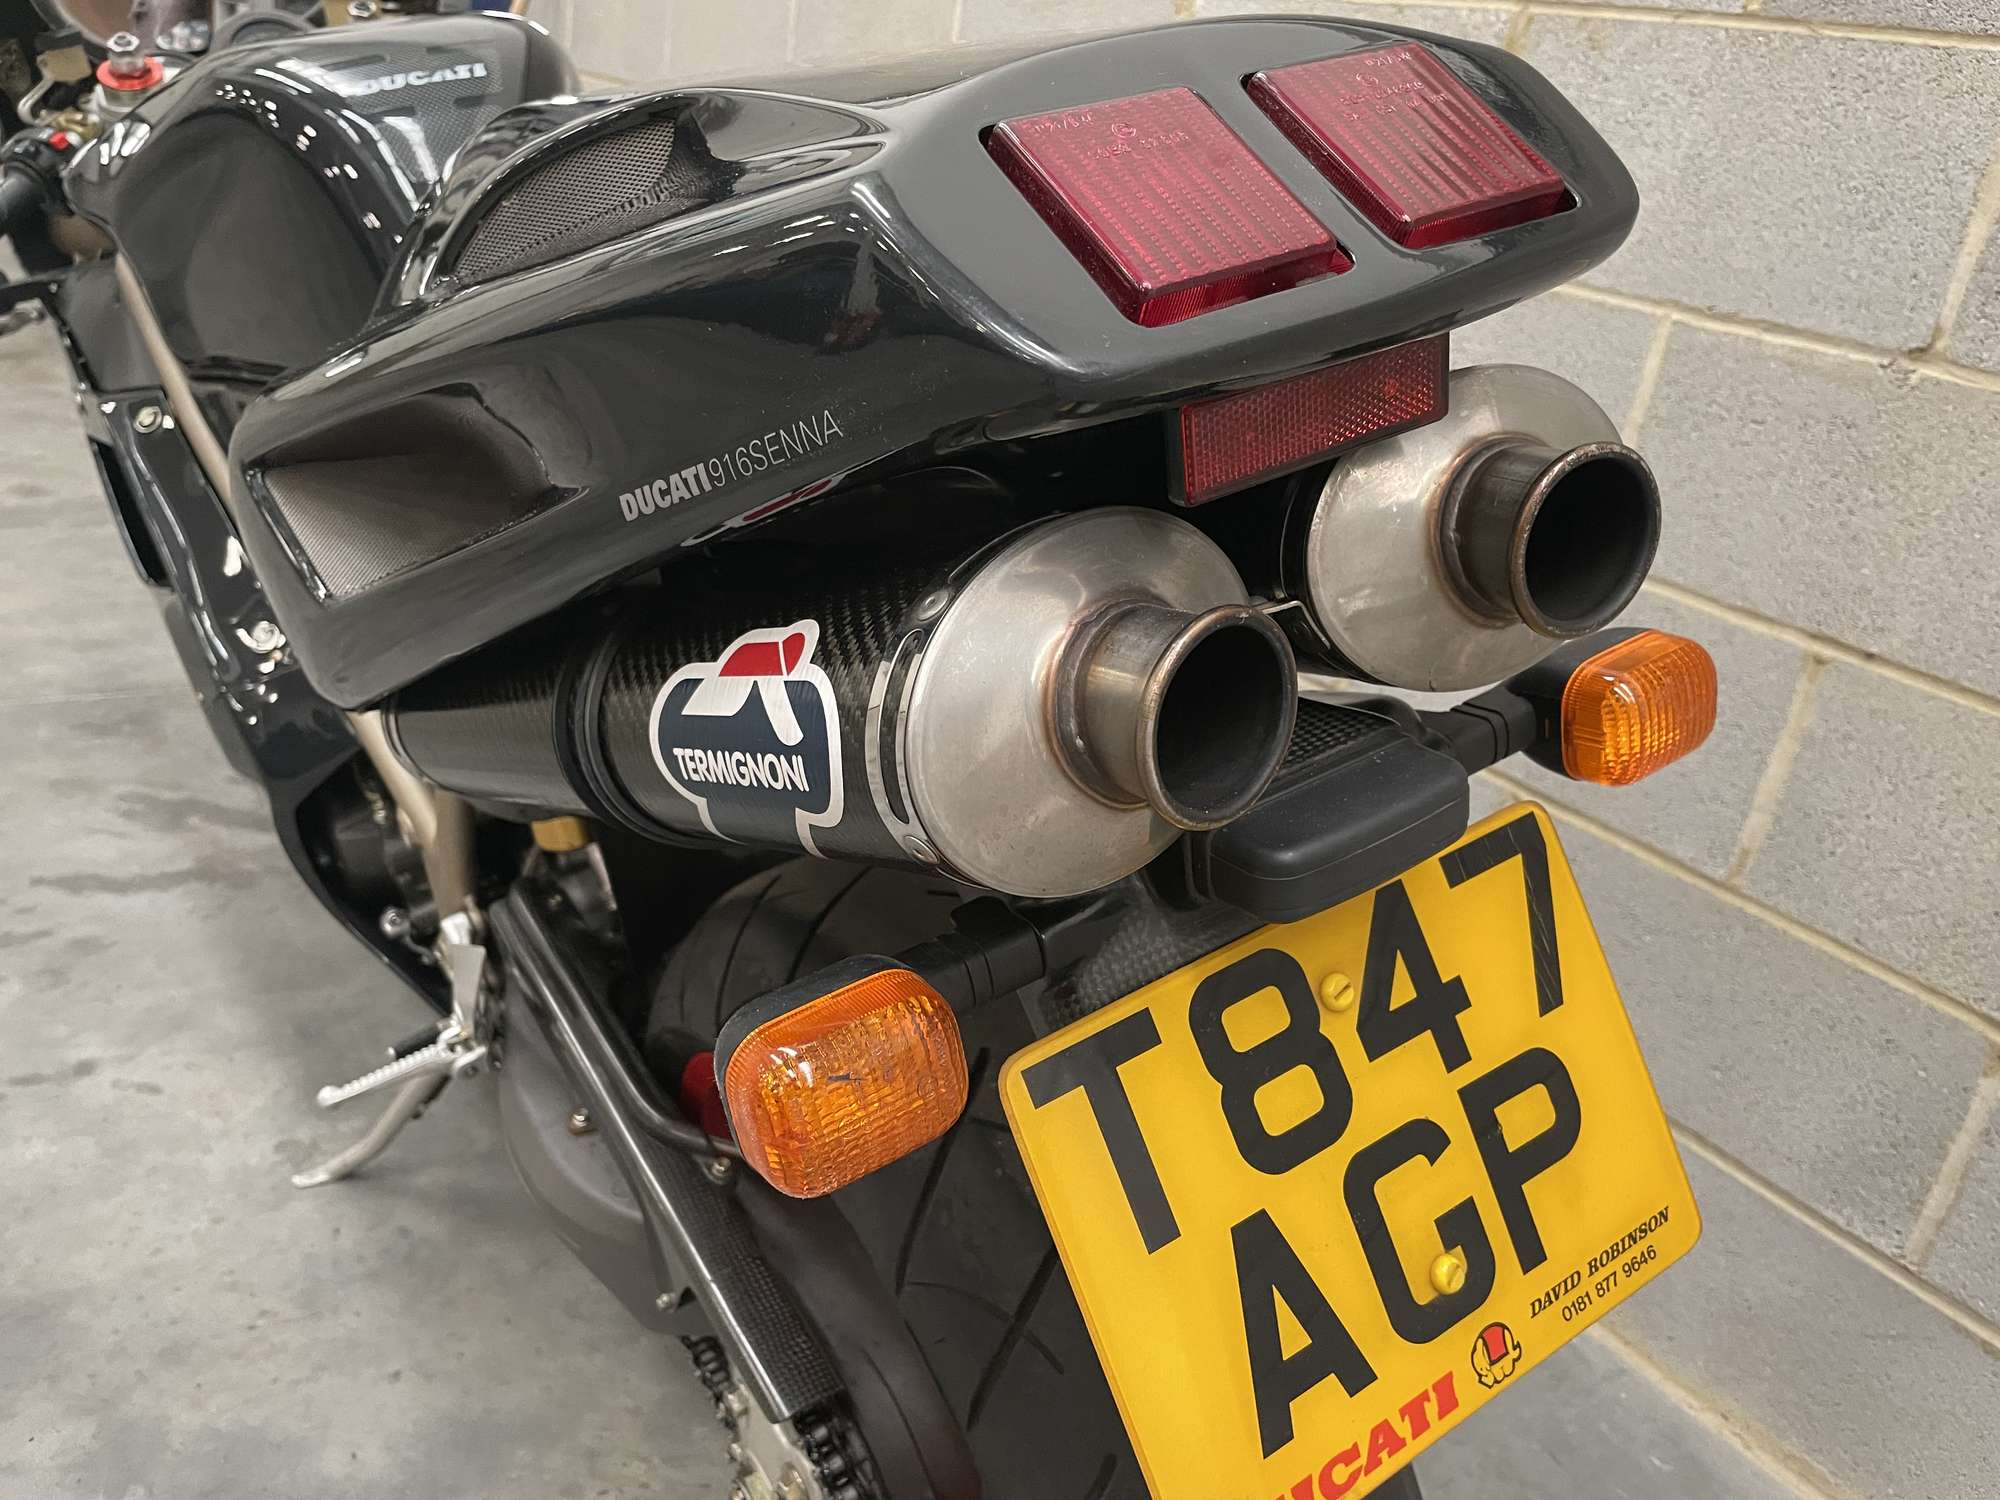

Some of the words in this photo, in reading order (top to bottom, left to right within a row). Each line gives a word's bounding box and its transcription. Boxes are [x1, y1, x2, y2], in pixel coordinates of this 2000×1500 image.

[352, 63, 488, 96] DUCATI
[672, 747, 810, 792] TERMIGNONI
[1020, 811, 1565, 1255] T847
[1230, 1047, 1582, 1459] AGP
[1528, 1270, 1582, 1319] DAVID
[1587, 1206, 1670, 1279] ROBINSON
[1561, 1290, 1594, 1322] 0181
[1594, 1270, 1618, 1299] 877
[1621, 1244, 1658, 1279] 9646
